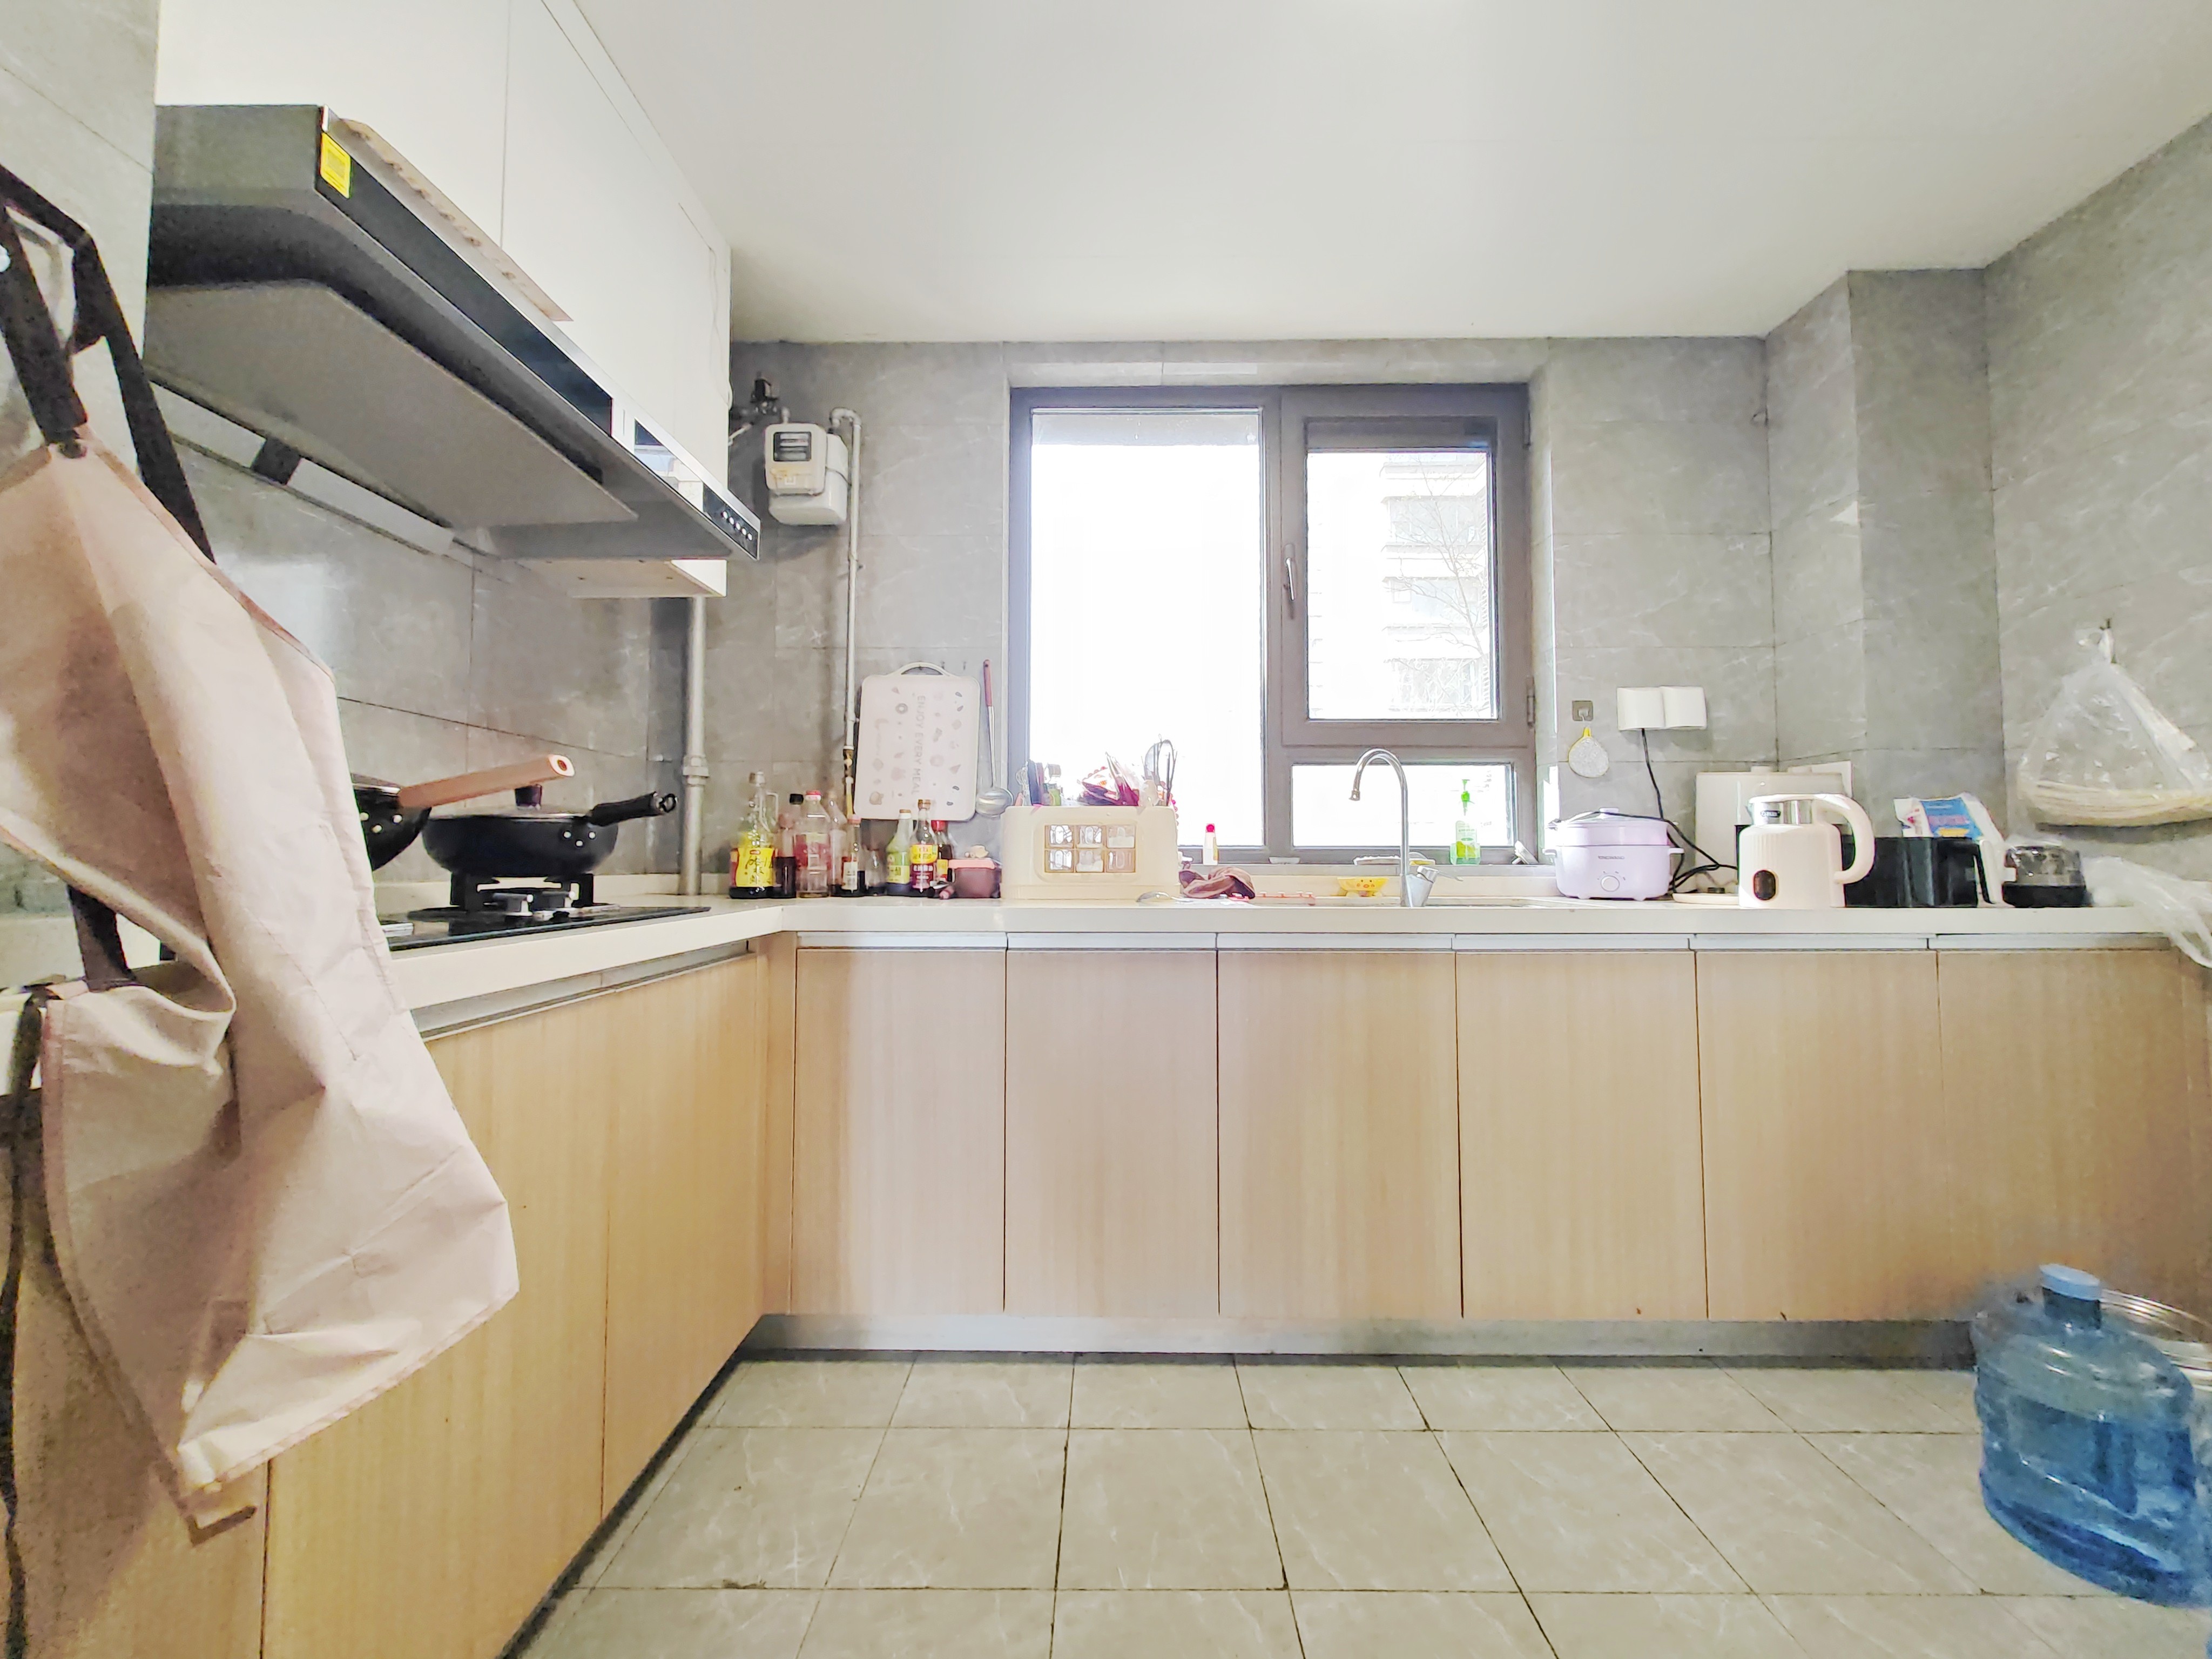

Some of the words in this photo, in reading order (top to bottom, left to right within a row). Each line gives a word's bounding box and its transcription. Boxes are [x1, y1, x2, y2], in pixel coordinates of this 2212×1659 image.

[916, 695, 926, 728] ENJOY
[914, 732, 923, 765] EVERY
[911, 768, 921, 795] MEAL
